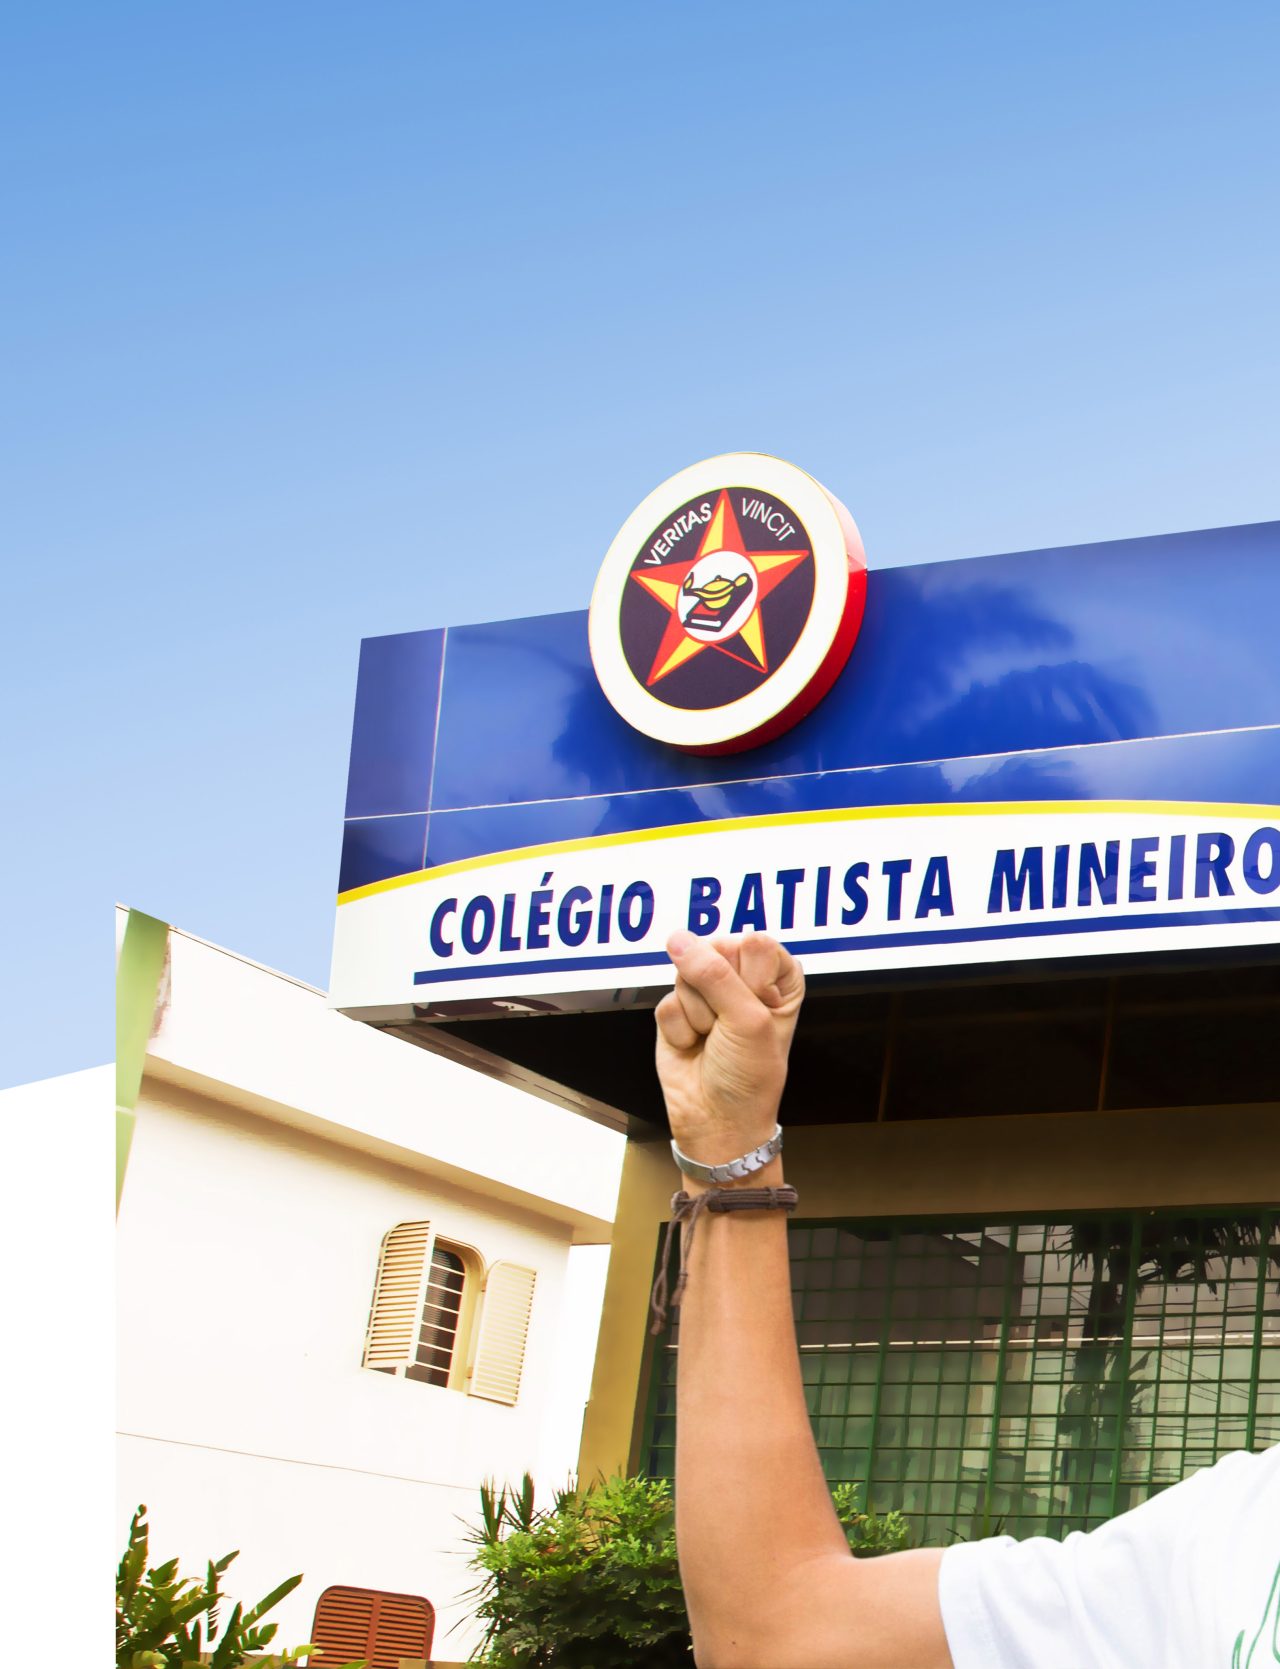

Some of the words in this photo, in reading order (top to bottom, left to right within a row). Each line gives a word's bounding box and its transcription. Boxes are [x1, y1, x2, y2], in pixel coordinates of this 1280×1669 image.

[644, 502, 712, 566] VERITAS
[742, 498, 796, 542] VINCIT
[429, 871, 655, 958] COLÉGIO
[687, 855, 955, 937] BATISTA
